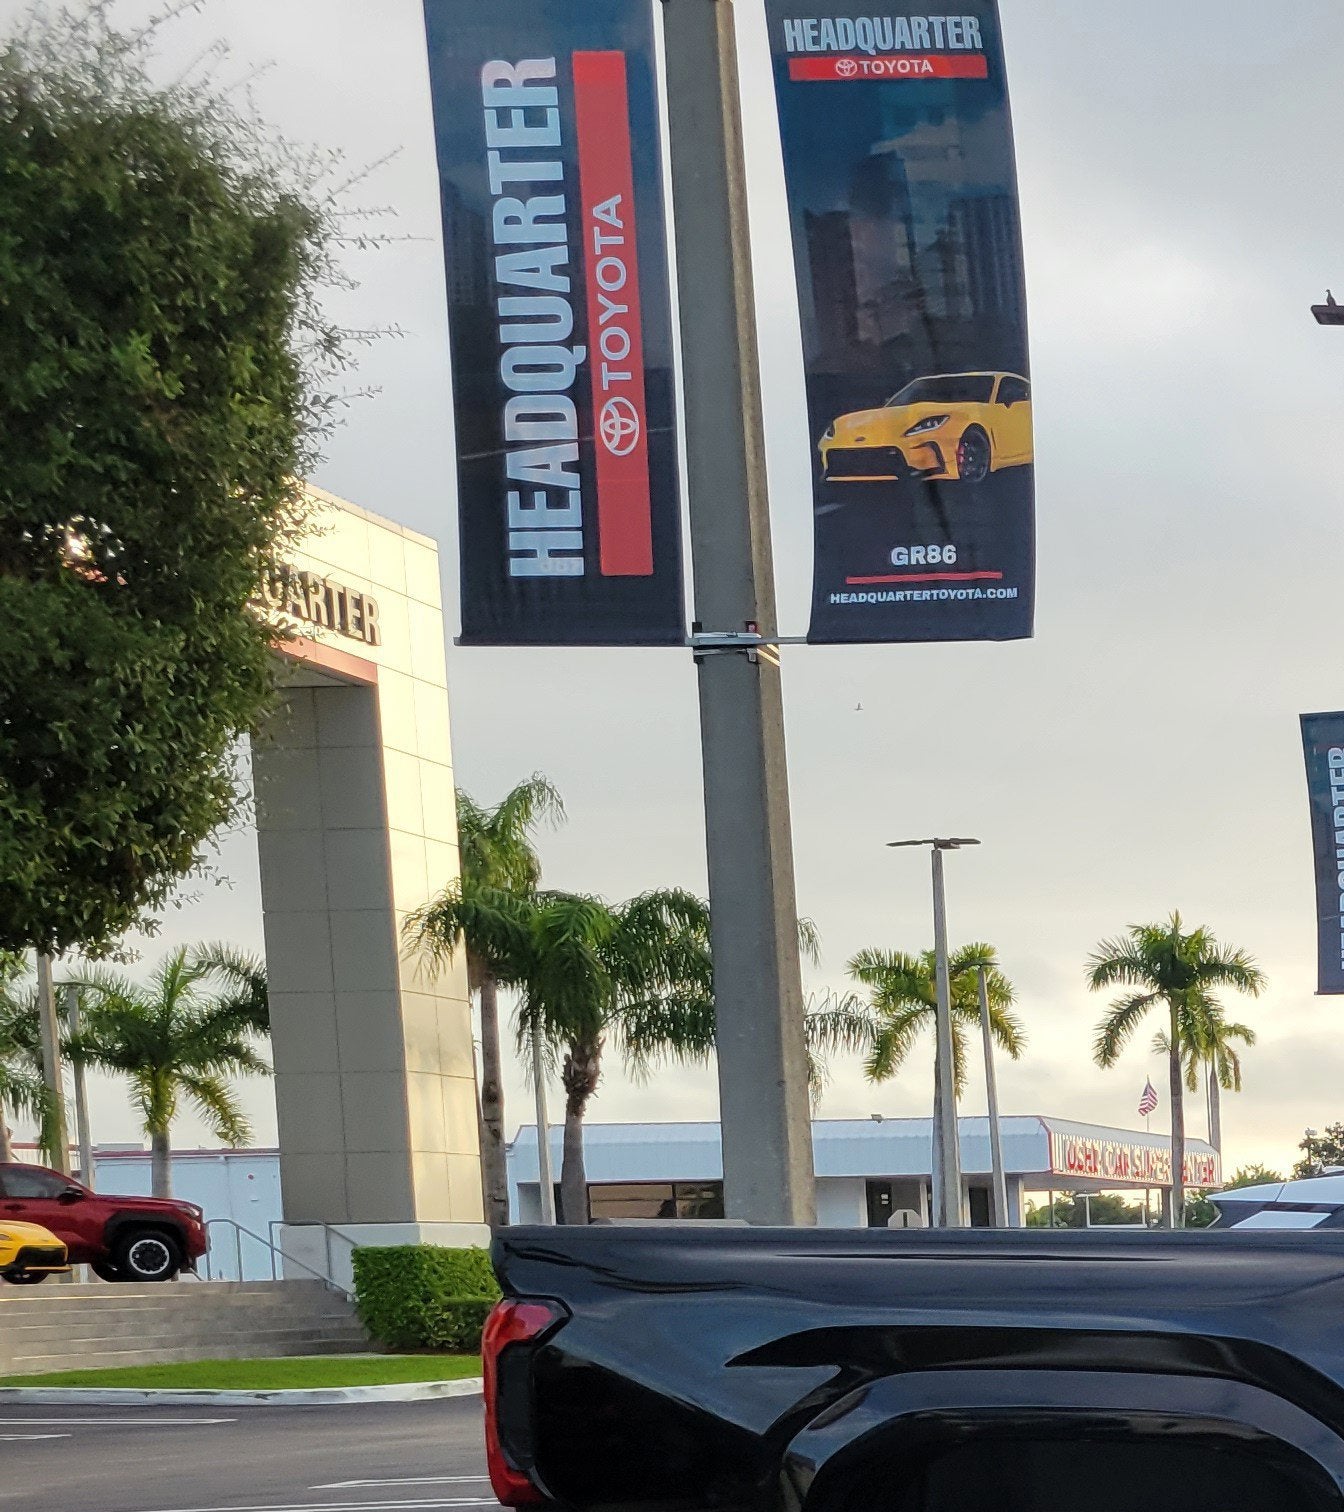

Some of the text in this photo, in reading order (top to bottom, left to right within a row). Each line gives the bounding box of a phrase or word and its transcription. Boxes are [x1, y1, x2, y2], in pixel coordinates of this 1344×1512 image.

[783, 15, 982, 54] HEADQUARTER
[858, 58, 934, 76] TOYOTA
[592, 194, 633, 388] TOYOTA
[480, 55, 586, 578] HEADQUARTER
[890, 543, 958, 567] GR86
[829, 585, 1018, 605] HEADQUARTERTOYOTA.COM
